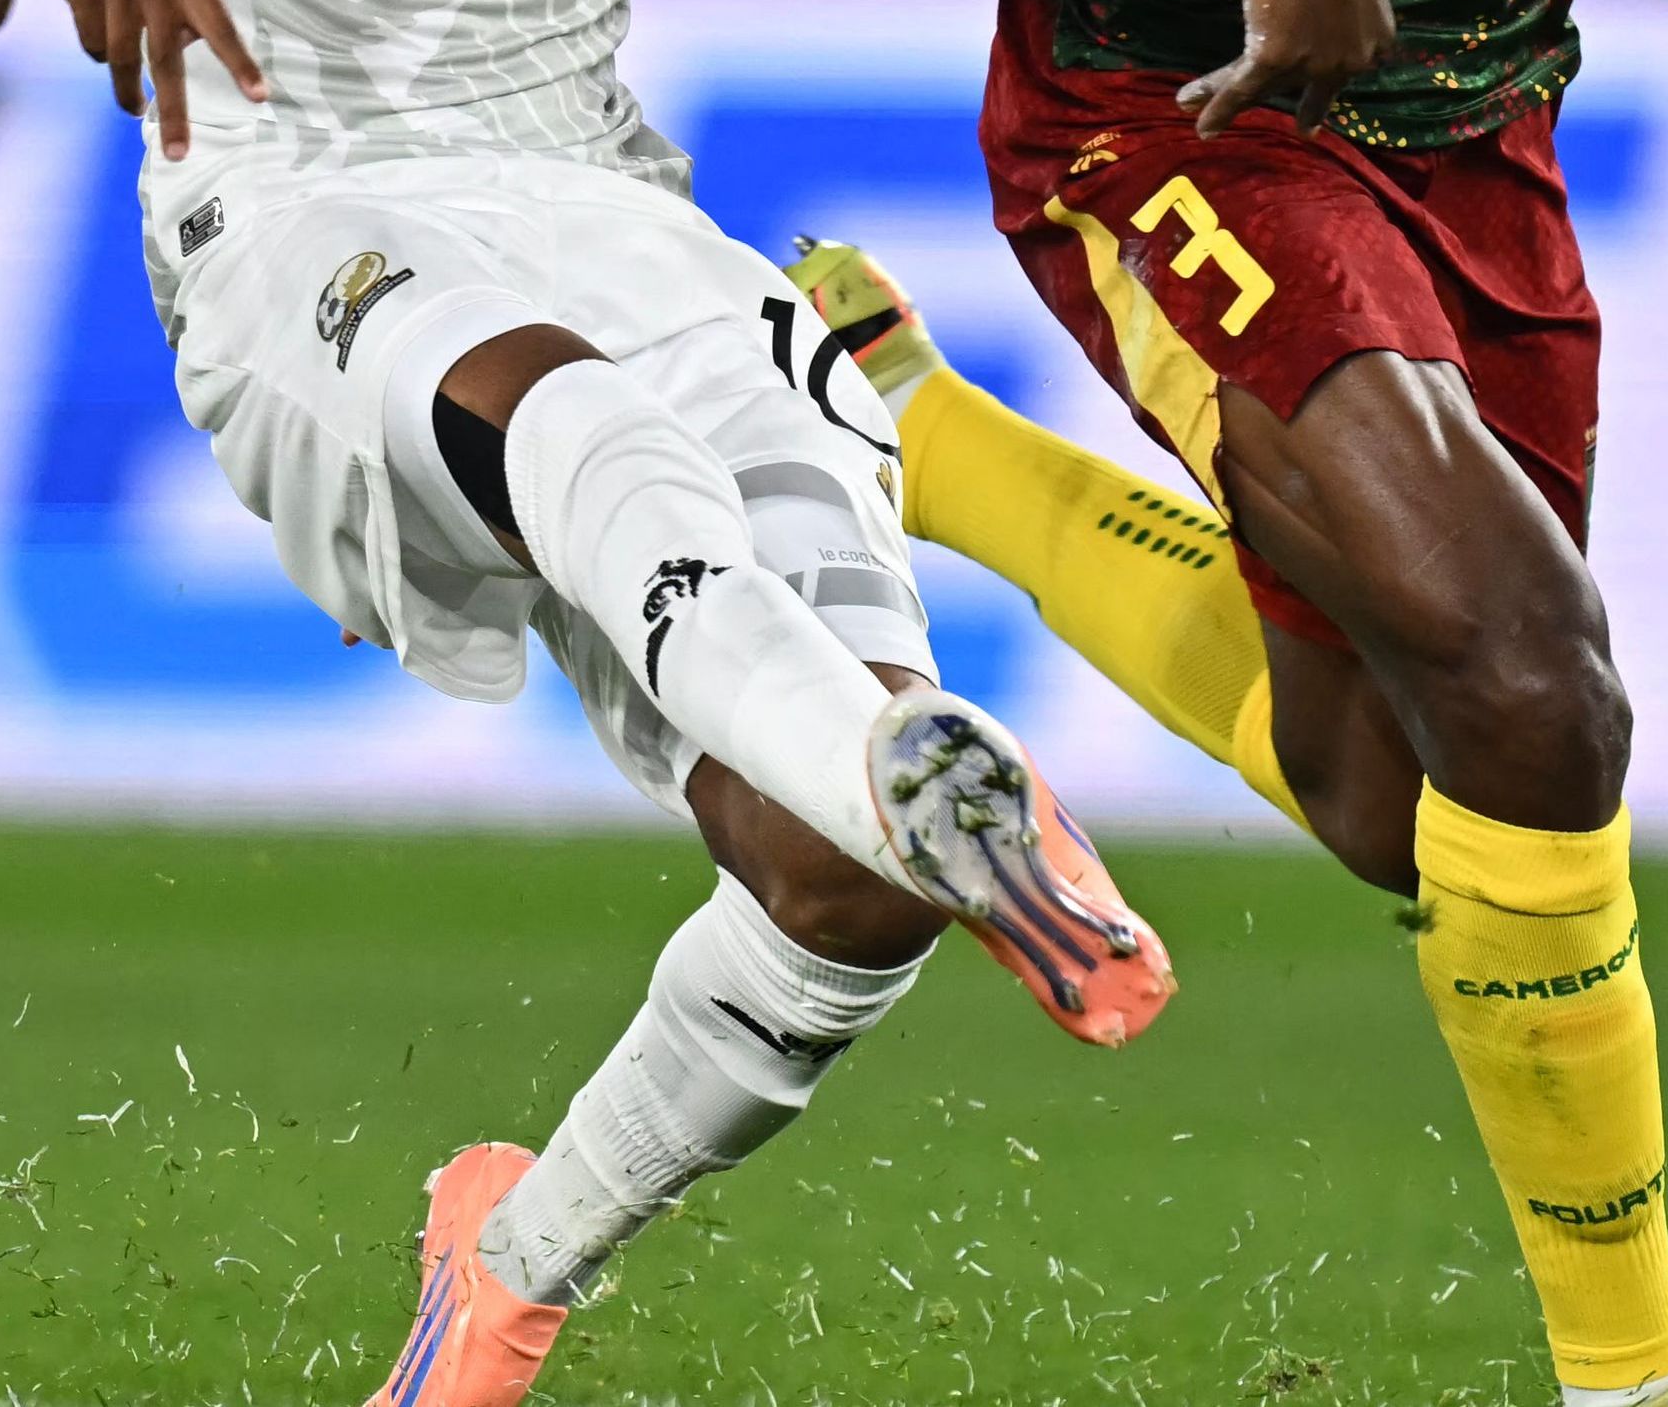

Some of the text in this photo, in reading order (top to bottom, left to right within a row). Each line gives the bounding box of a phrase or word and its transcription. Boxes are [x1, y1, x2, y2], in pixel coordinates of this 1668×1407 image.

[1128, 174, 1276, 337] 3
[818, 547, 837, 562] le
[838, 550, 872, 567] coq
[1528, 1163, 1668, 1225] FOURT
